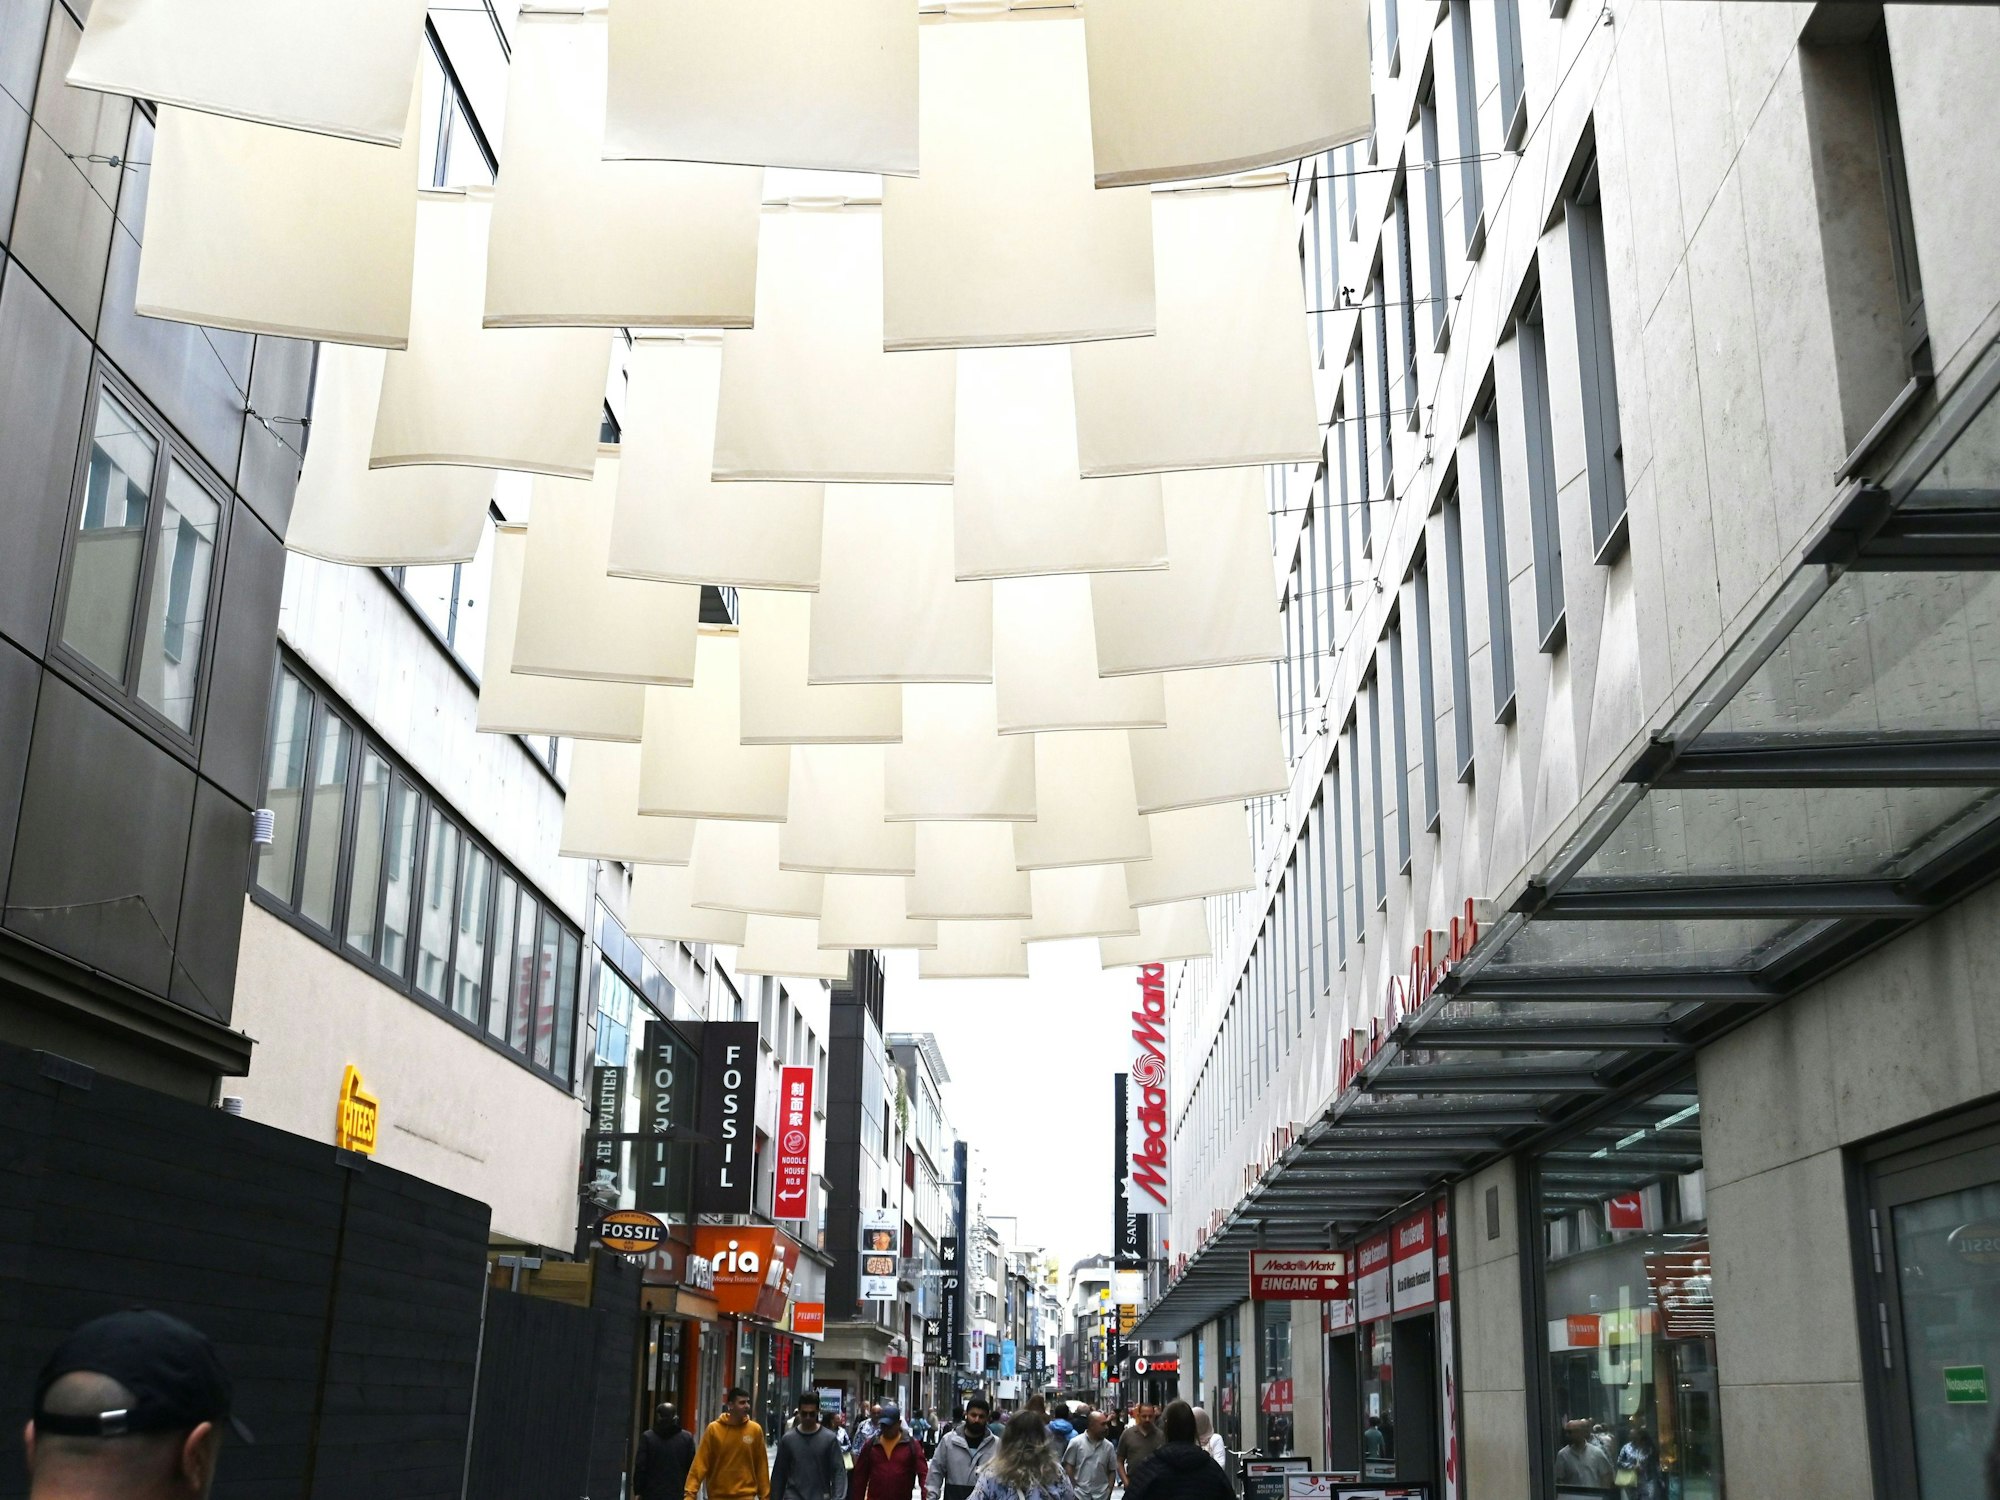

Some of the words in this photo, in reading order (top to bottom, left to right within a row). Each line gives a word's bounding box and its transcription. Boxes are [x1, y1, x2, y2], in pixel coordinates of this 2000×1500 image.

[720, 1045, 742, 1188] FOSSIL
[1131, 1086, 1167, 1207] Media
[782, 1156, 807, 1165] NOODLE
[783, 1167, 805, 1175] HOUSE
[601, 1223, 660, 1241] FOSSIL
[712, 1240, 759, 1273] ria
[1262, 1259, 1298, 1271] Media
[1304, 1260, 1336, 1271] Markt
[943, 1278, 958, 1289] JD
[1261, 1276, 1318, 1292] EINGANG
[1945, 1377, 1985, 1394] Notausgang
